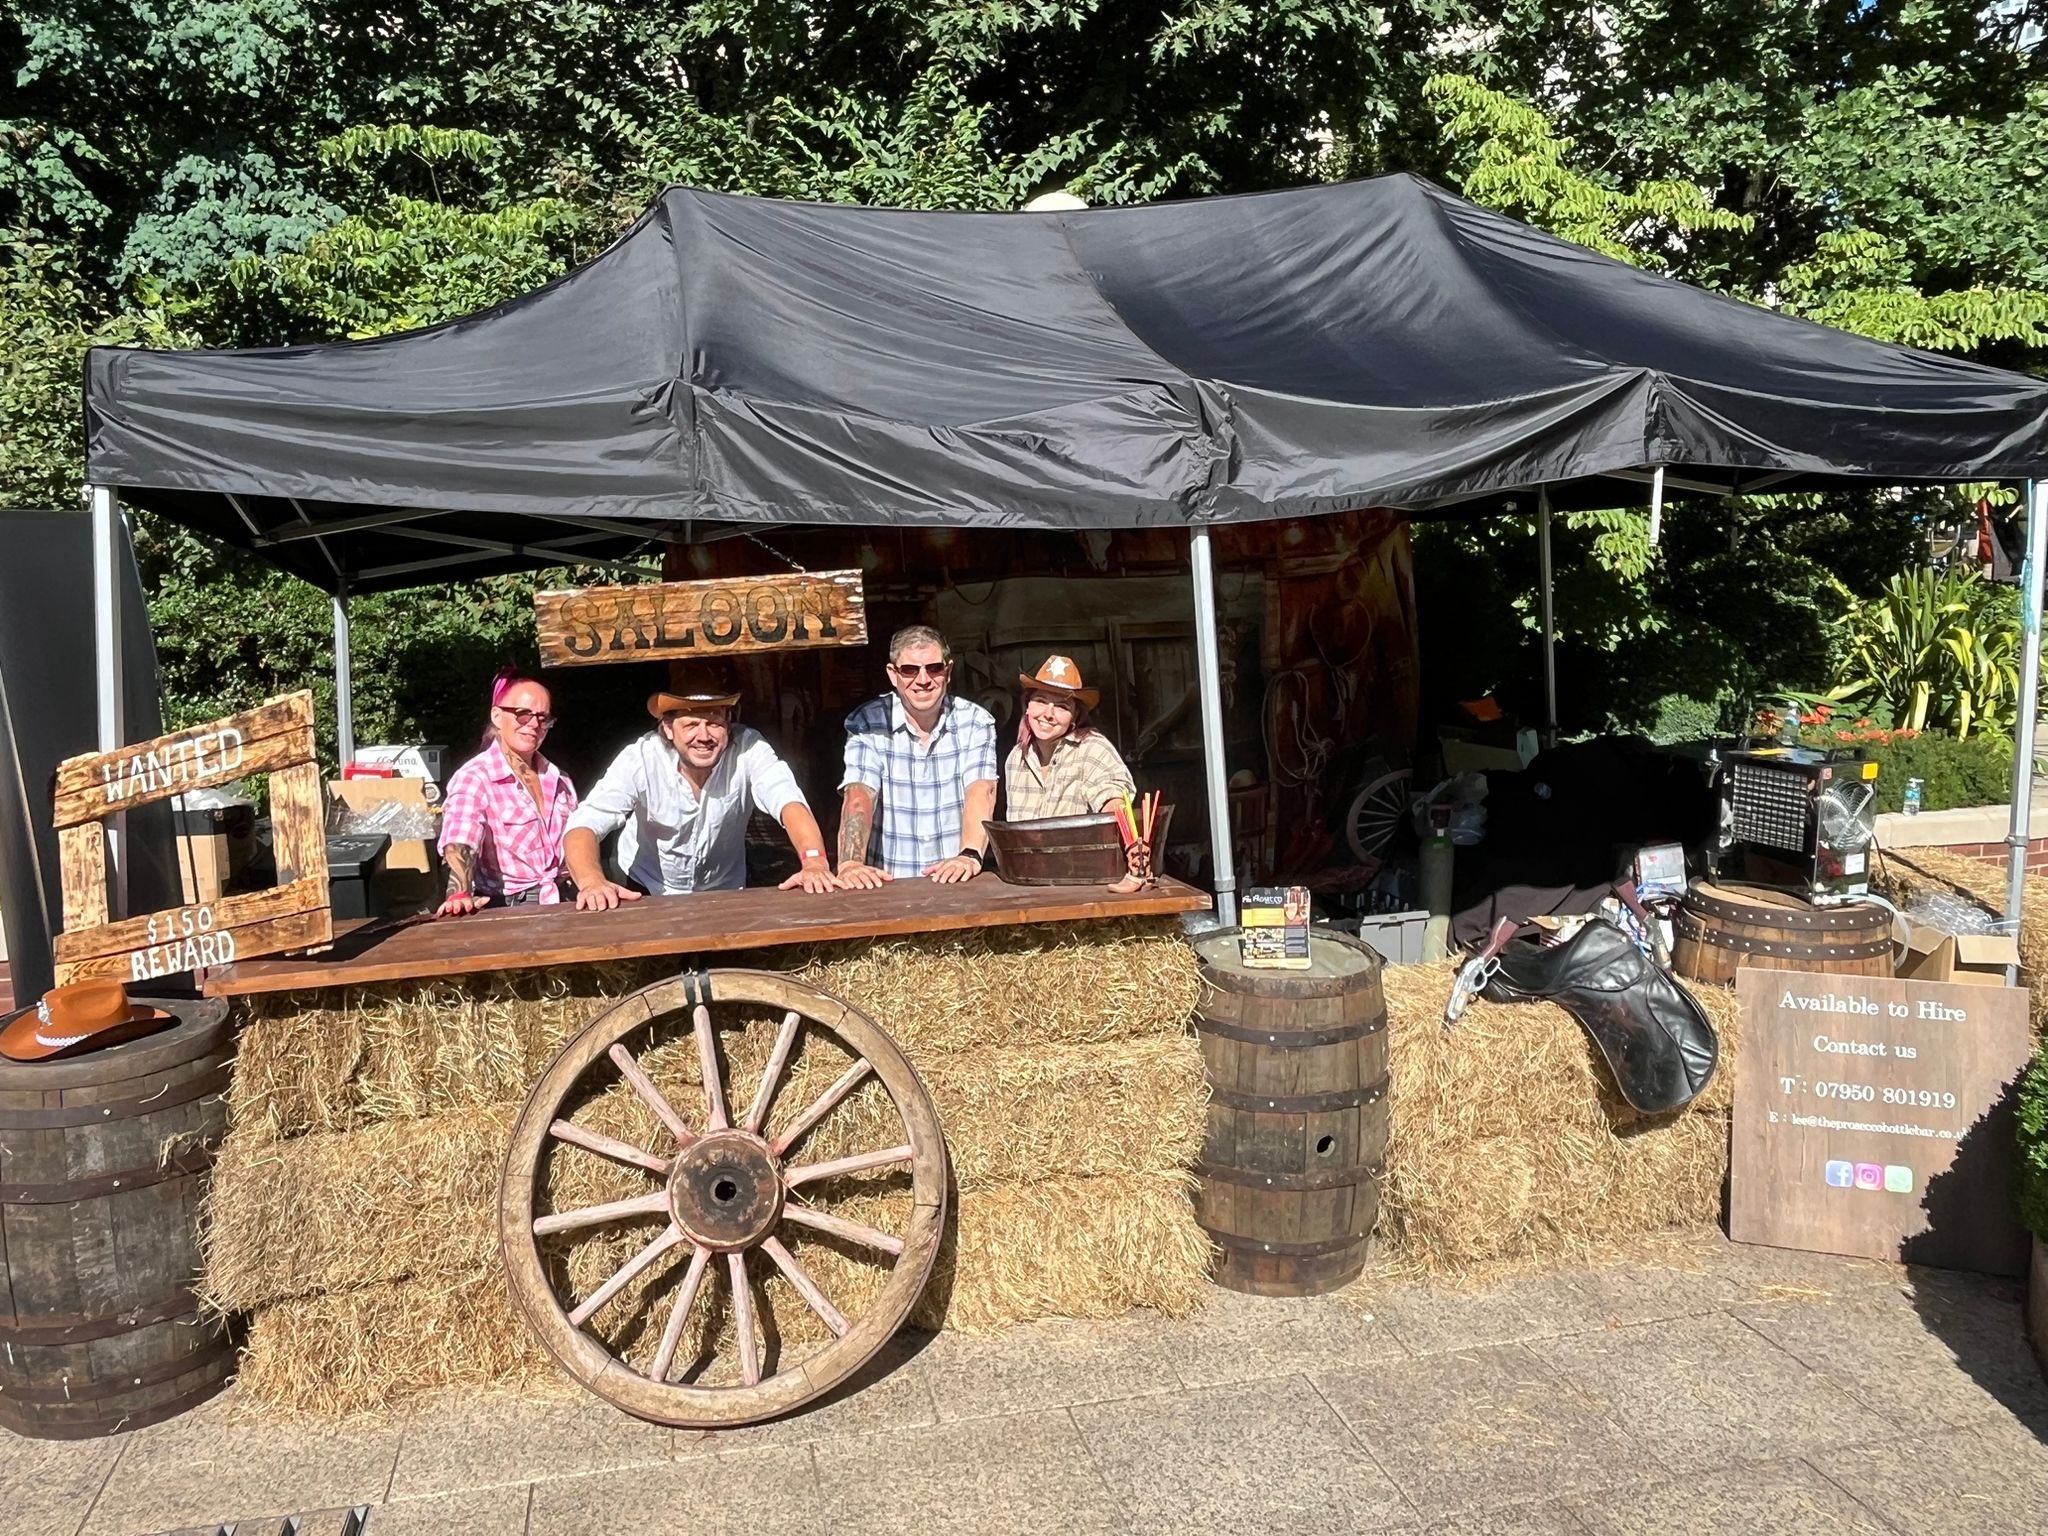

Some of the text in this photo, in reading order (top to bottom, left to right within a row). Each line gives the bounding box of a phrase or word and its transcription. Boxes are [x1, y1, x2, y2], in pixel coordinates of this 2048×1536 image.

[560, 584, 837, 657] SALOON
[103, 728, 243, 803] WANTED
[147, 906, 212, 945] $150
[131, 930, 235, 982] REWARD
[1779, 991, 1967, 1022] Available to Hire
[1814, 1035, 1917, 1059] Contact us
[1815, 1081, 1875, 1102] 07950
[1882, 1088, 1956, 1109] 801919
